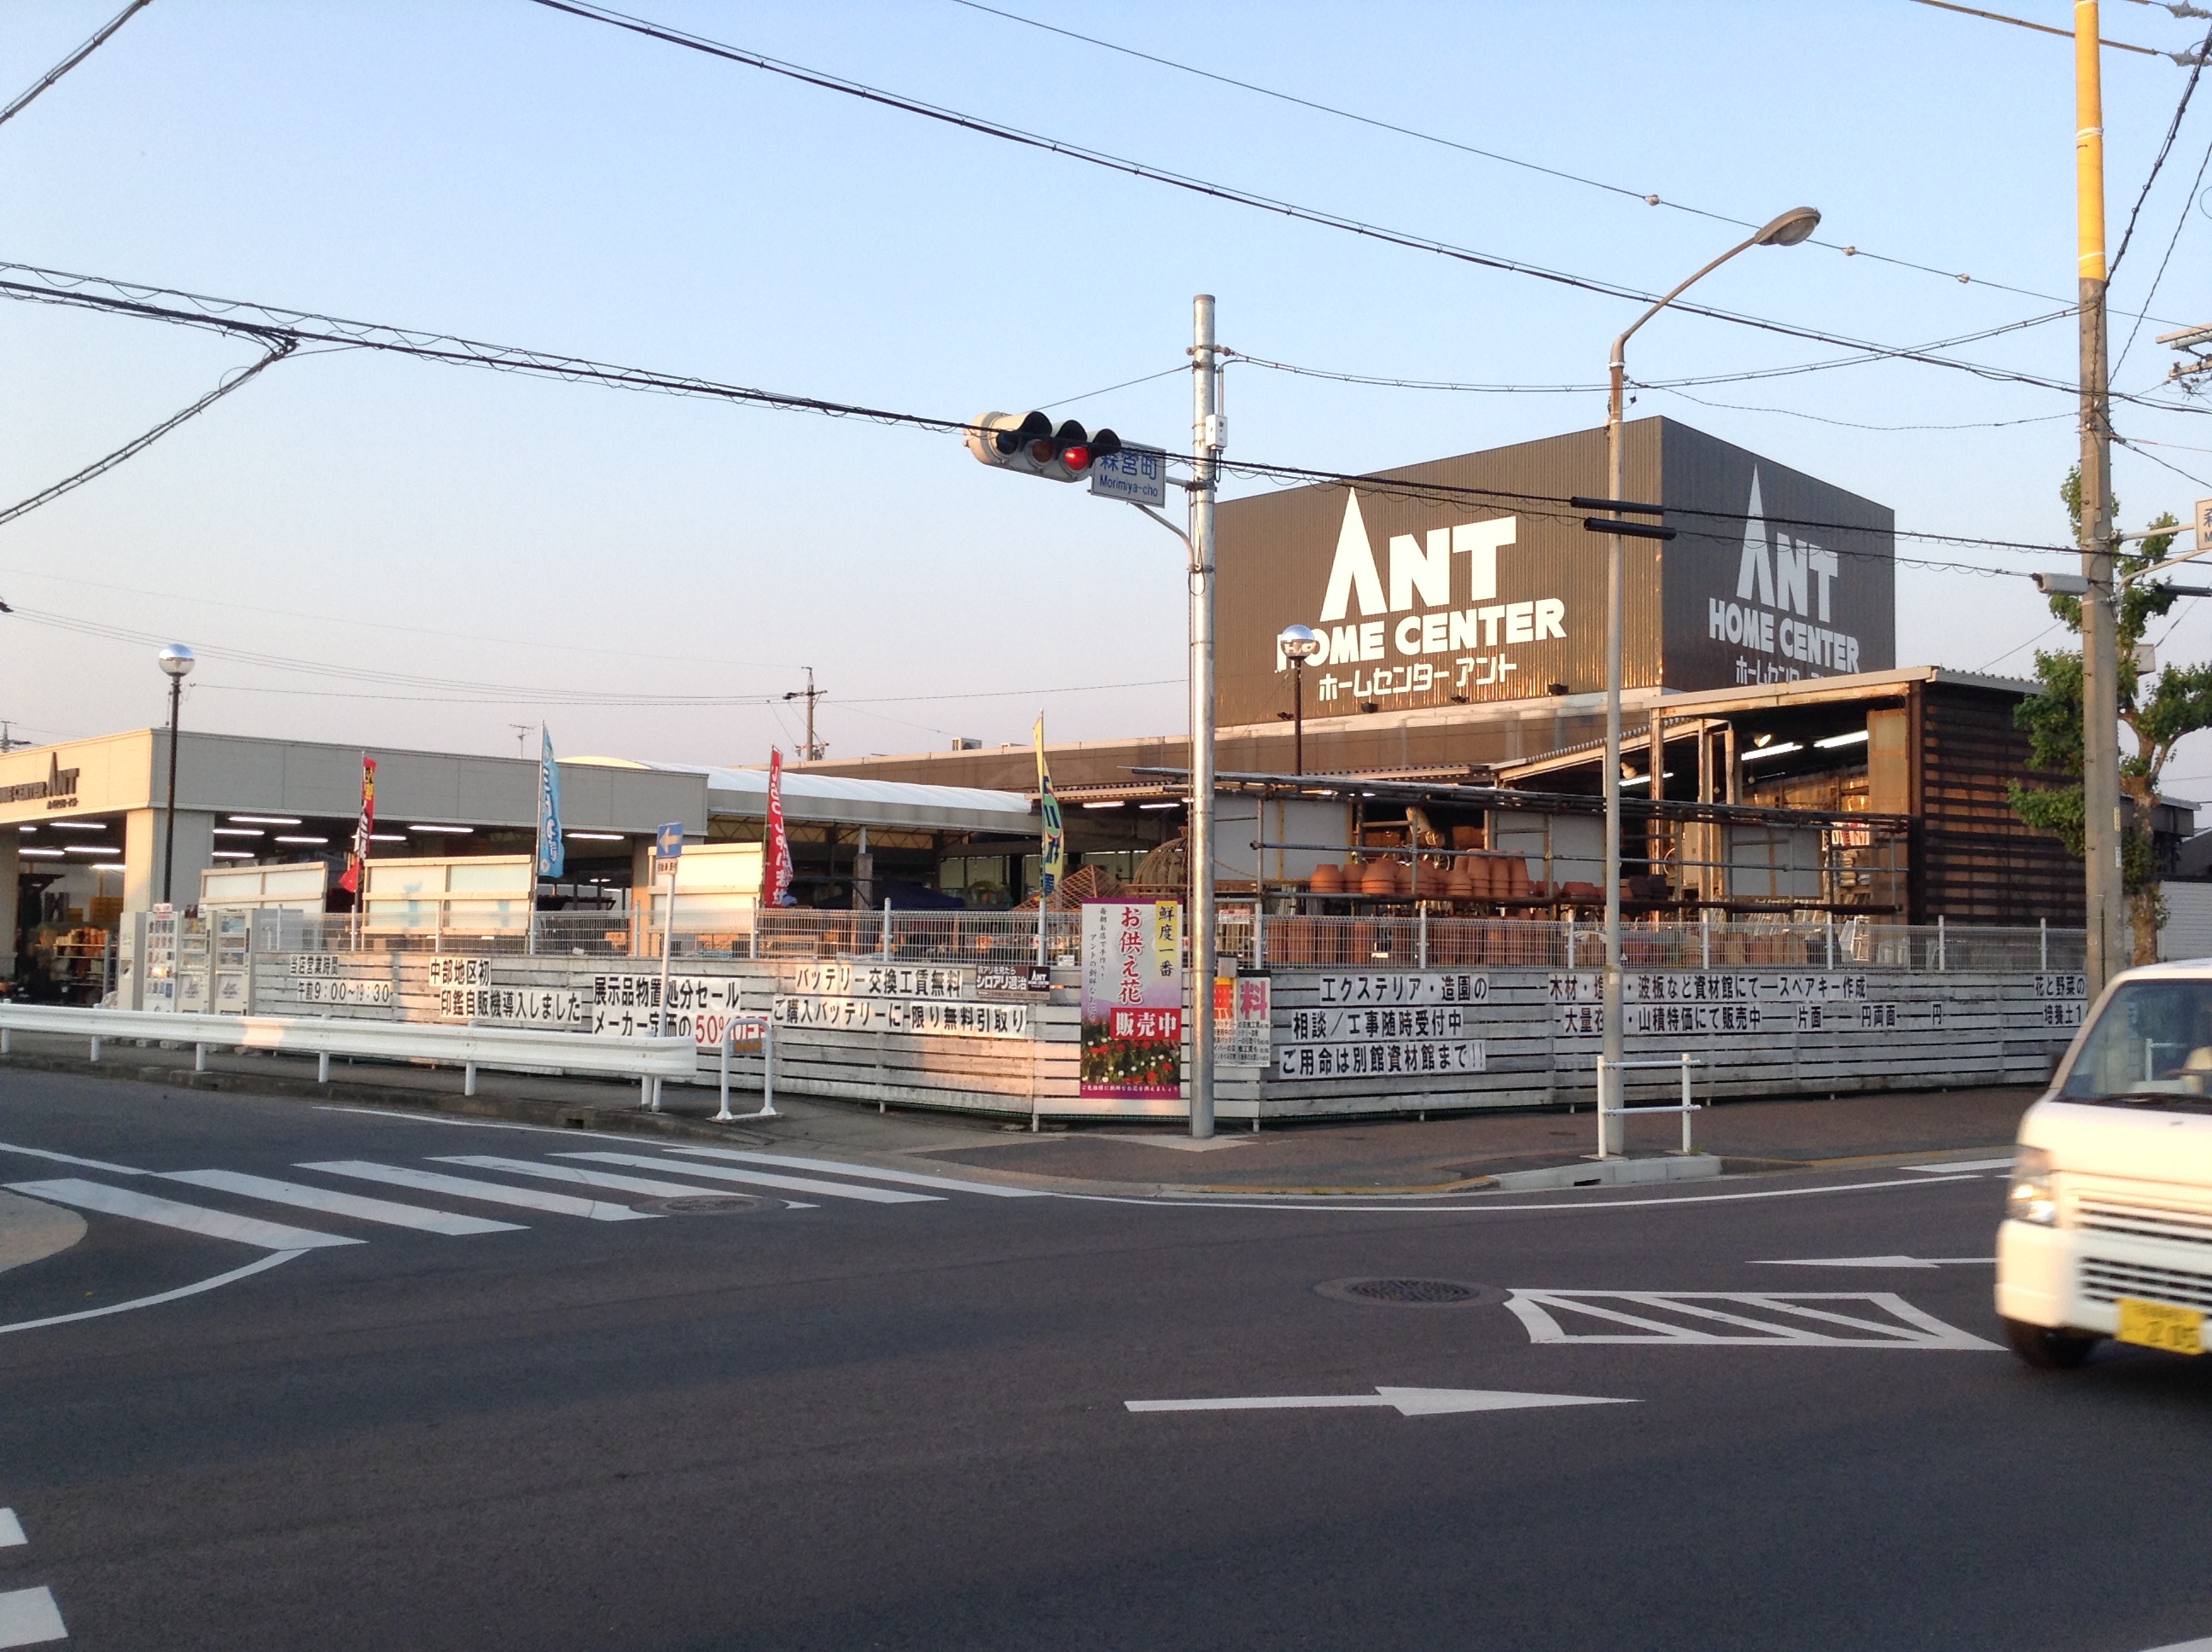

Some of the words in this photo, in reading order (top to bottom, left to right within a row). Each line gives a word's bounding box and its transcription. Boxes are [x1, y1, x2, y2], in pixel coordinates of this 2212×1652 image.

[1099, 474, 1158, 497] Morimiya-cho
[1319, 487, 1516, 622] ANT
[1737, 463, 1838, 623] ANT
[1276, 621, 1384, 672] OME
[1395, 597, 1567, 655] CENTER
[1709, 598, 1774, 653] HOME
[1779, 618, 1860, 673] CENTER
[1318, 663, 1450, 701] ホームセンター
[1456, 654, 1517, 688] アント
[1120, 906, 1144, 1005] お供え花
[1158, 905, 1175, 977] 鮮度一番
[430, 957, 489, 986] 中部地区初
[797, 968, 961, 998] バッテリー交換工賃無料
[976, 975, 1027, 990] シロアリ退治
[1780, 975, 1866, 998] スペアキー作成
[593, 976, 740, 1009] 展示品物置処分セール
[1322, 975, 1487, 1002] エクステリア・造園の
[441, 989, 580, 1021] 印鑑自販機導入しました
[1115, 1012, 1177, 1038] 販売中
